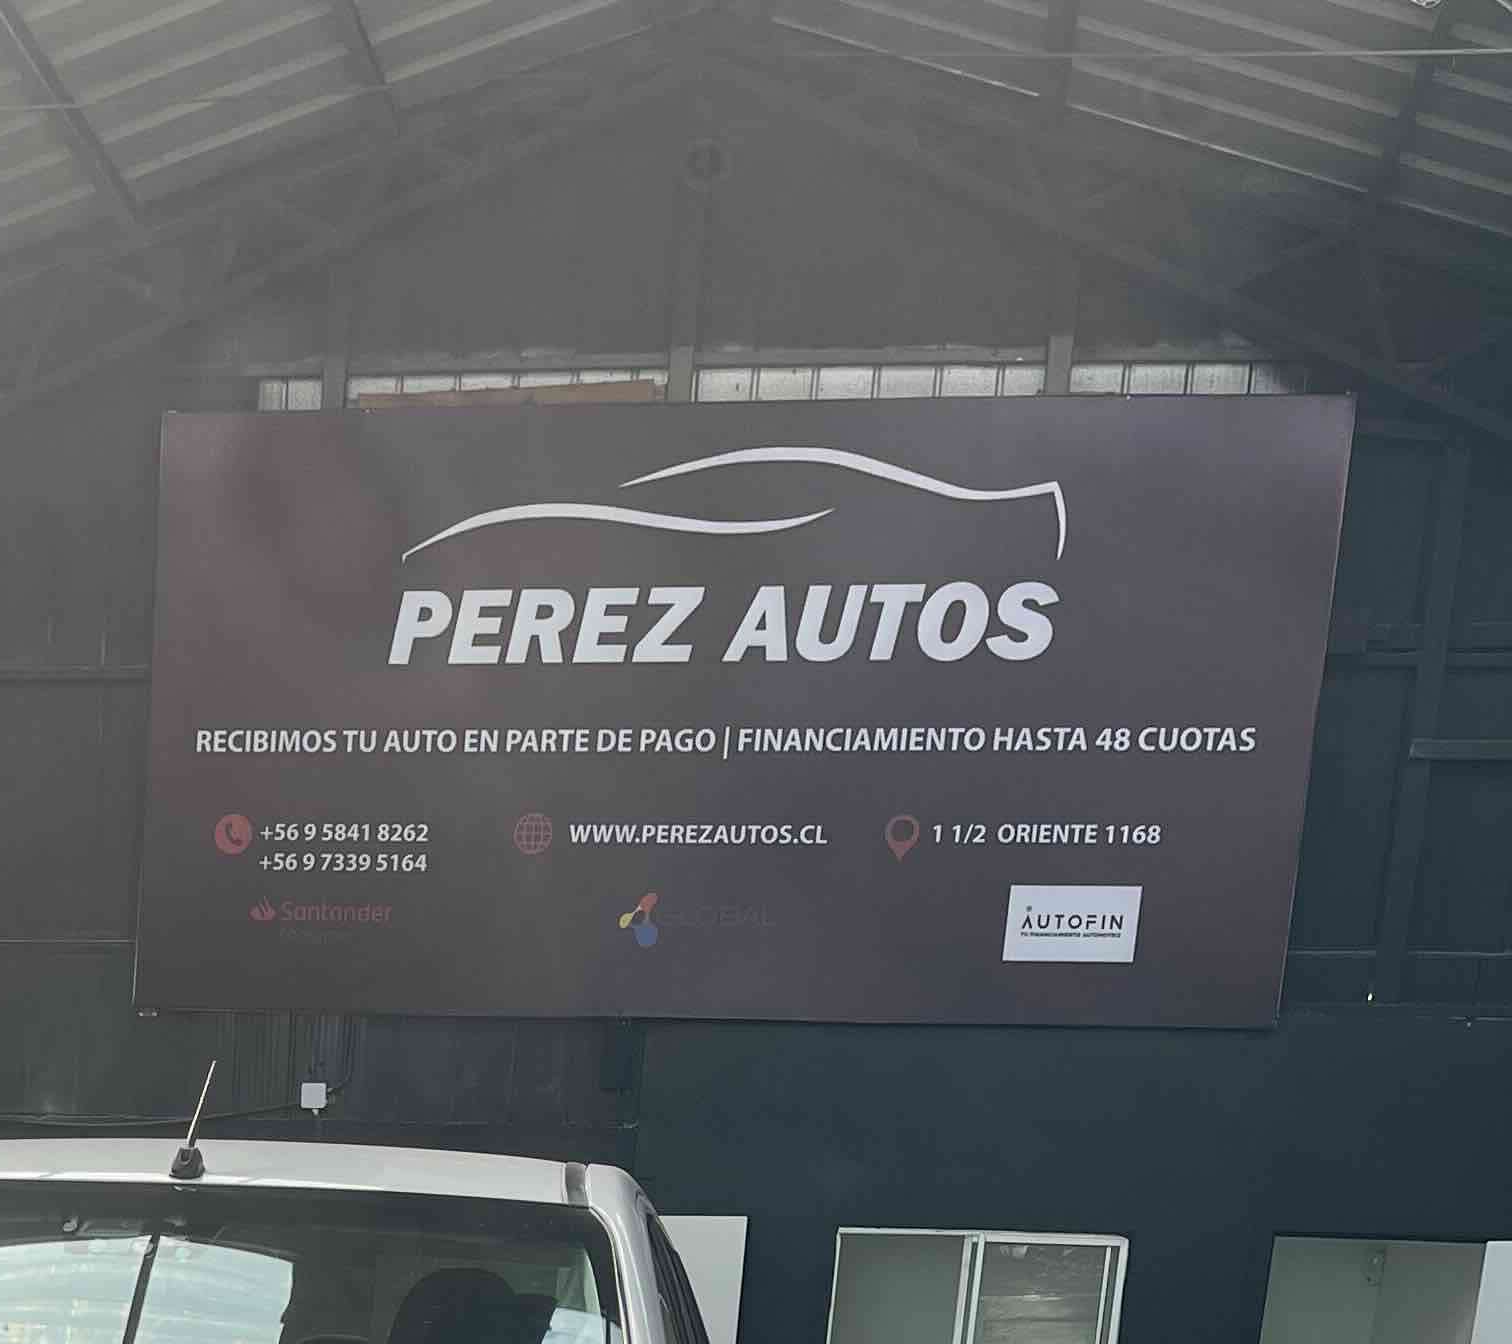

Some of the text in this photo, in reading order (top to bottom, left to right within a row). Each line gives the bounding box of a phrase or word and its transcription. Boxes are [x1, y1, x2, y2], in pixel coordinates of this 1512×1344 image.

[387, 581, 1060, 665] PEREZ AUTOS
[196, 729, 337, 753] RECIBIMOS
[342, 729, 377, 753] TU
[383, 729, 457, 753] AUTO
[463, 729, 499, 753] EN
[505, 728, 590, 753] PARTE
[596, 728, 633, 753] DE
[639, 728, 717, 753] PAGO
[737, 727, 986, 752] FINANCIAMIENTO
[992, 727, 1088, 752] HASTA
[1095, 727, 1131, 752] 48
[1138, 726, 1257, 752] CUOTAS
[259, 823, 429, 842] +56 9 5841 8262
[569, 823, 828, 845] WWW.PEREZAUTOS.CL
[933, 823, 1161, 845] 1 1/2 ORIENTE 1168
[259, 852, 428, 872] +56 9 7339 5164
[281, 902, 392, 922] Santander
[1021, 911, 1124, 930] AUTOFIN
